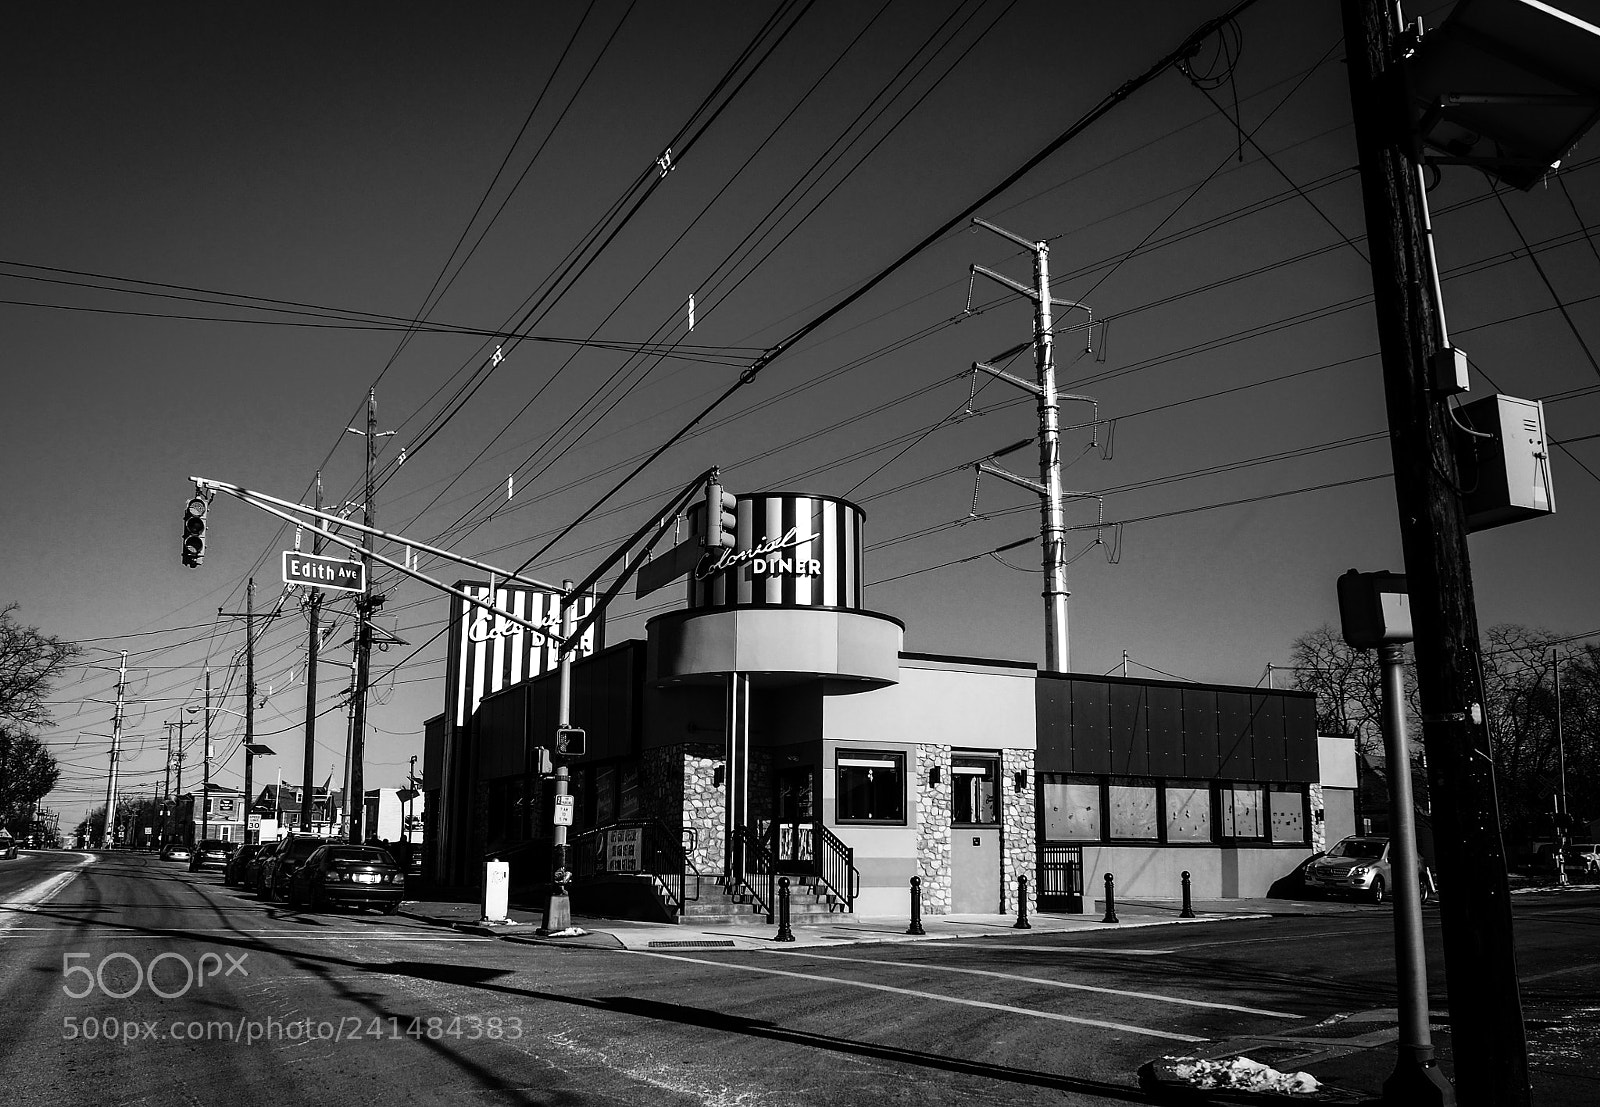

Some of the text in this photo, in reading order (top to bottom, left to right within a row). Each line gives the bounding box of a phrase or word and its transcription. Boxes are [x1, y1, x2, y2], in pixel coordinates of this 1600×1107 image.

[695, 527, 820, 581] Colonial
[291, 560, 357, 581] Edith Ave
[753, 558, 822, 575] DINER
